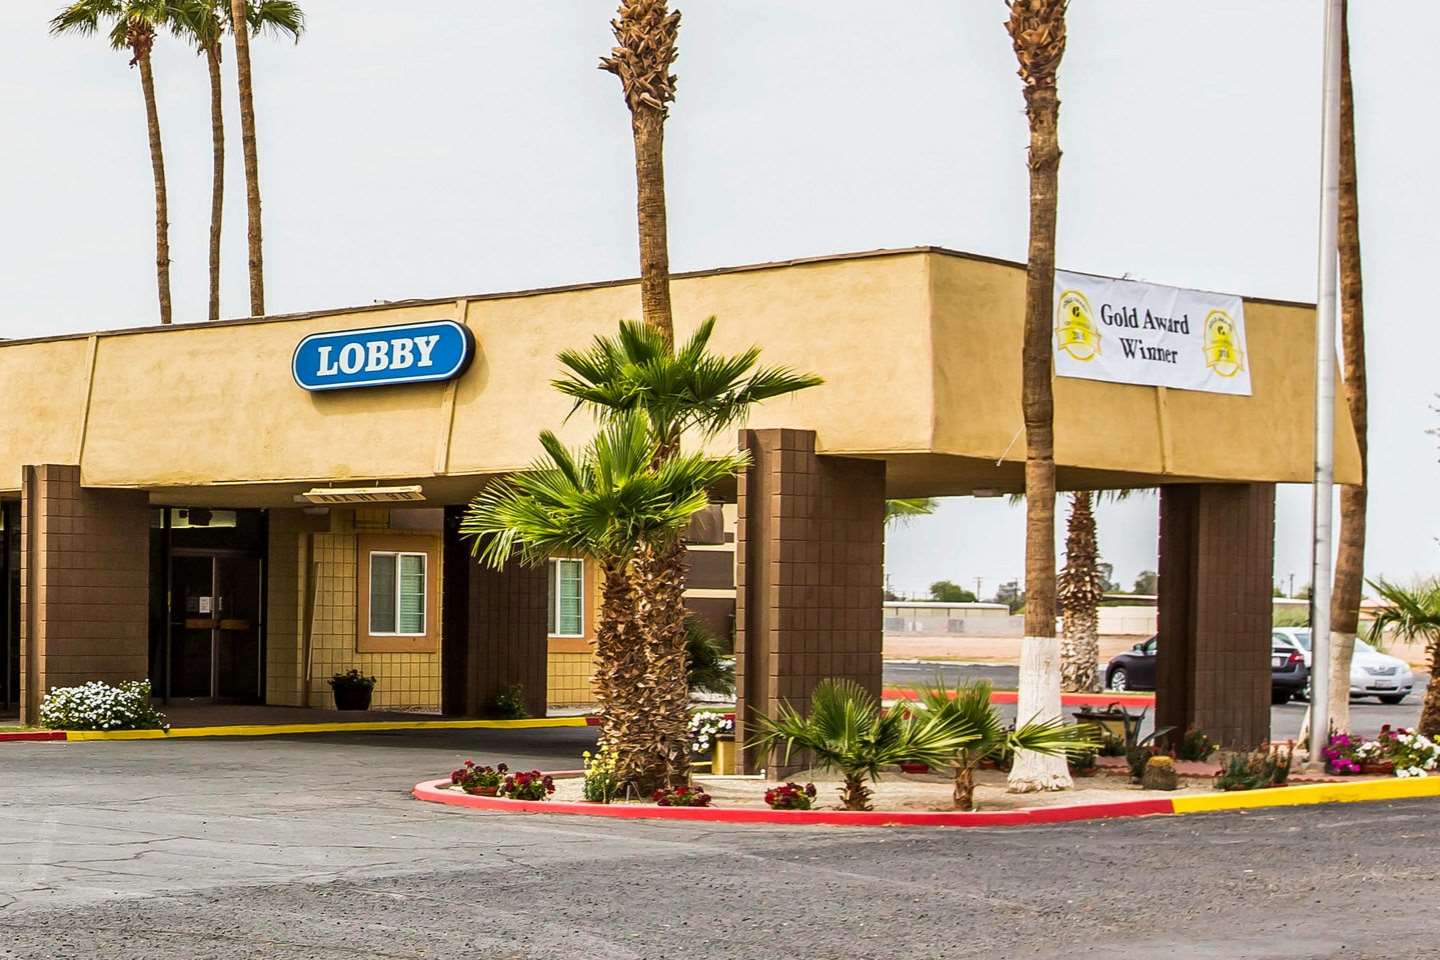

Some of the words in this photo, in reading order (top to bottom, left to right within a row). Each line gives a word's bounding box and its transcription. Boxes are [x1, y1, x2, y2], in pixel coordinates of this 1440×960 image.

[1100, 303, 1139, 329] Gold
[1142, 308, 1190, 335] Award
[316, 335, 440, 377] LOBBY
[1118, 337, 1178, 364] Winner
